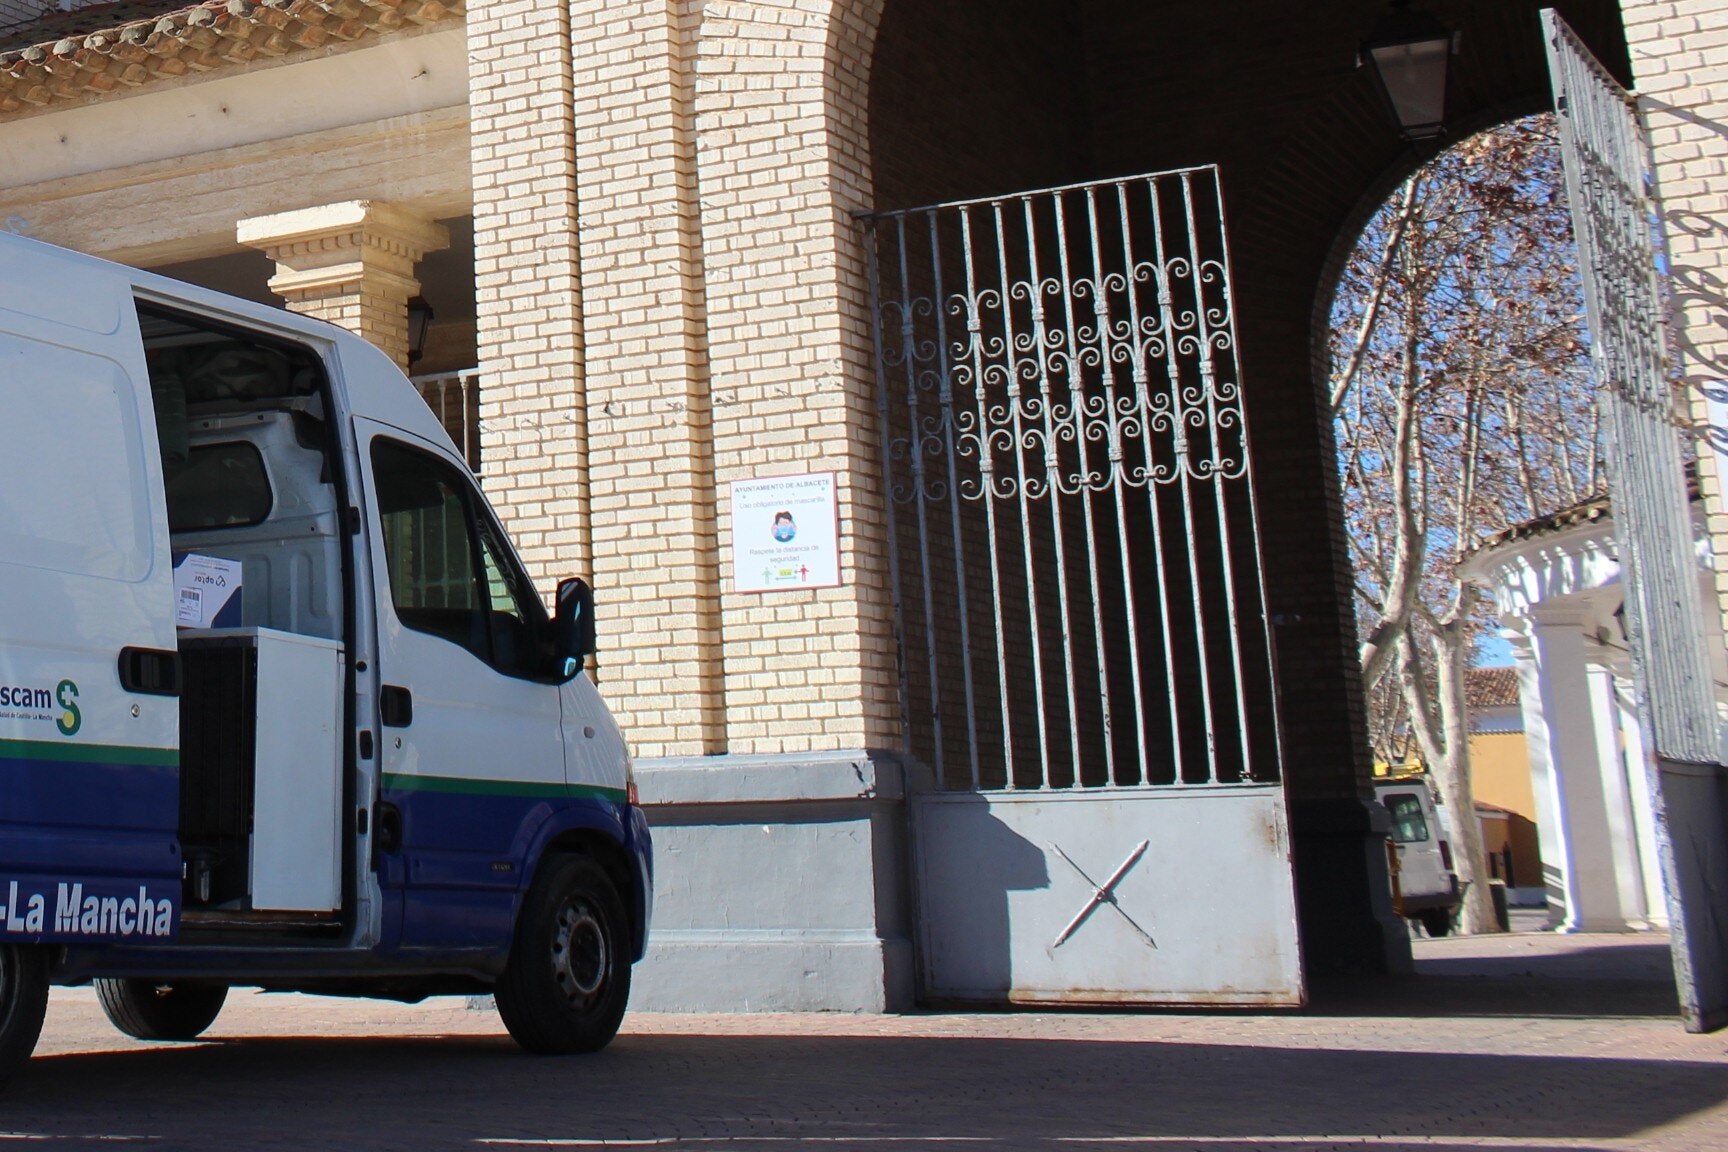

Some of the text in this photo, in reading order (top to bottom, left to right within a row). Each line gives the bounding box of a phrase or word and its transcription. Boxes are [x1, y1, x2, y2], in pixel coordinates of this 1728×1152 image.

[734, 479, 830, 494] AYUNTAMIENTO DE ALBACETE
[54, 882, 173, 937] Mancha
